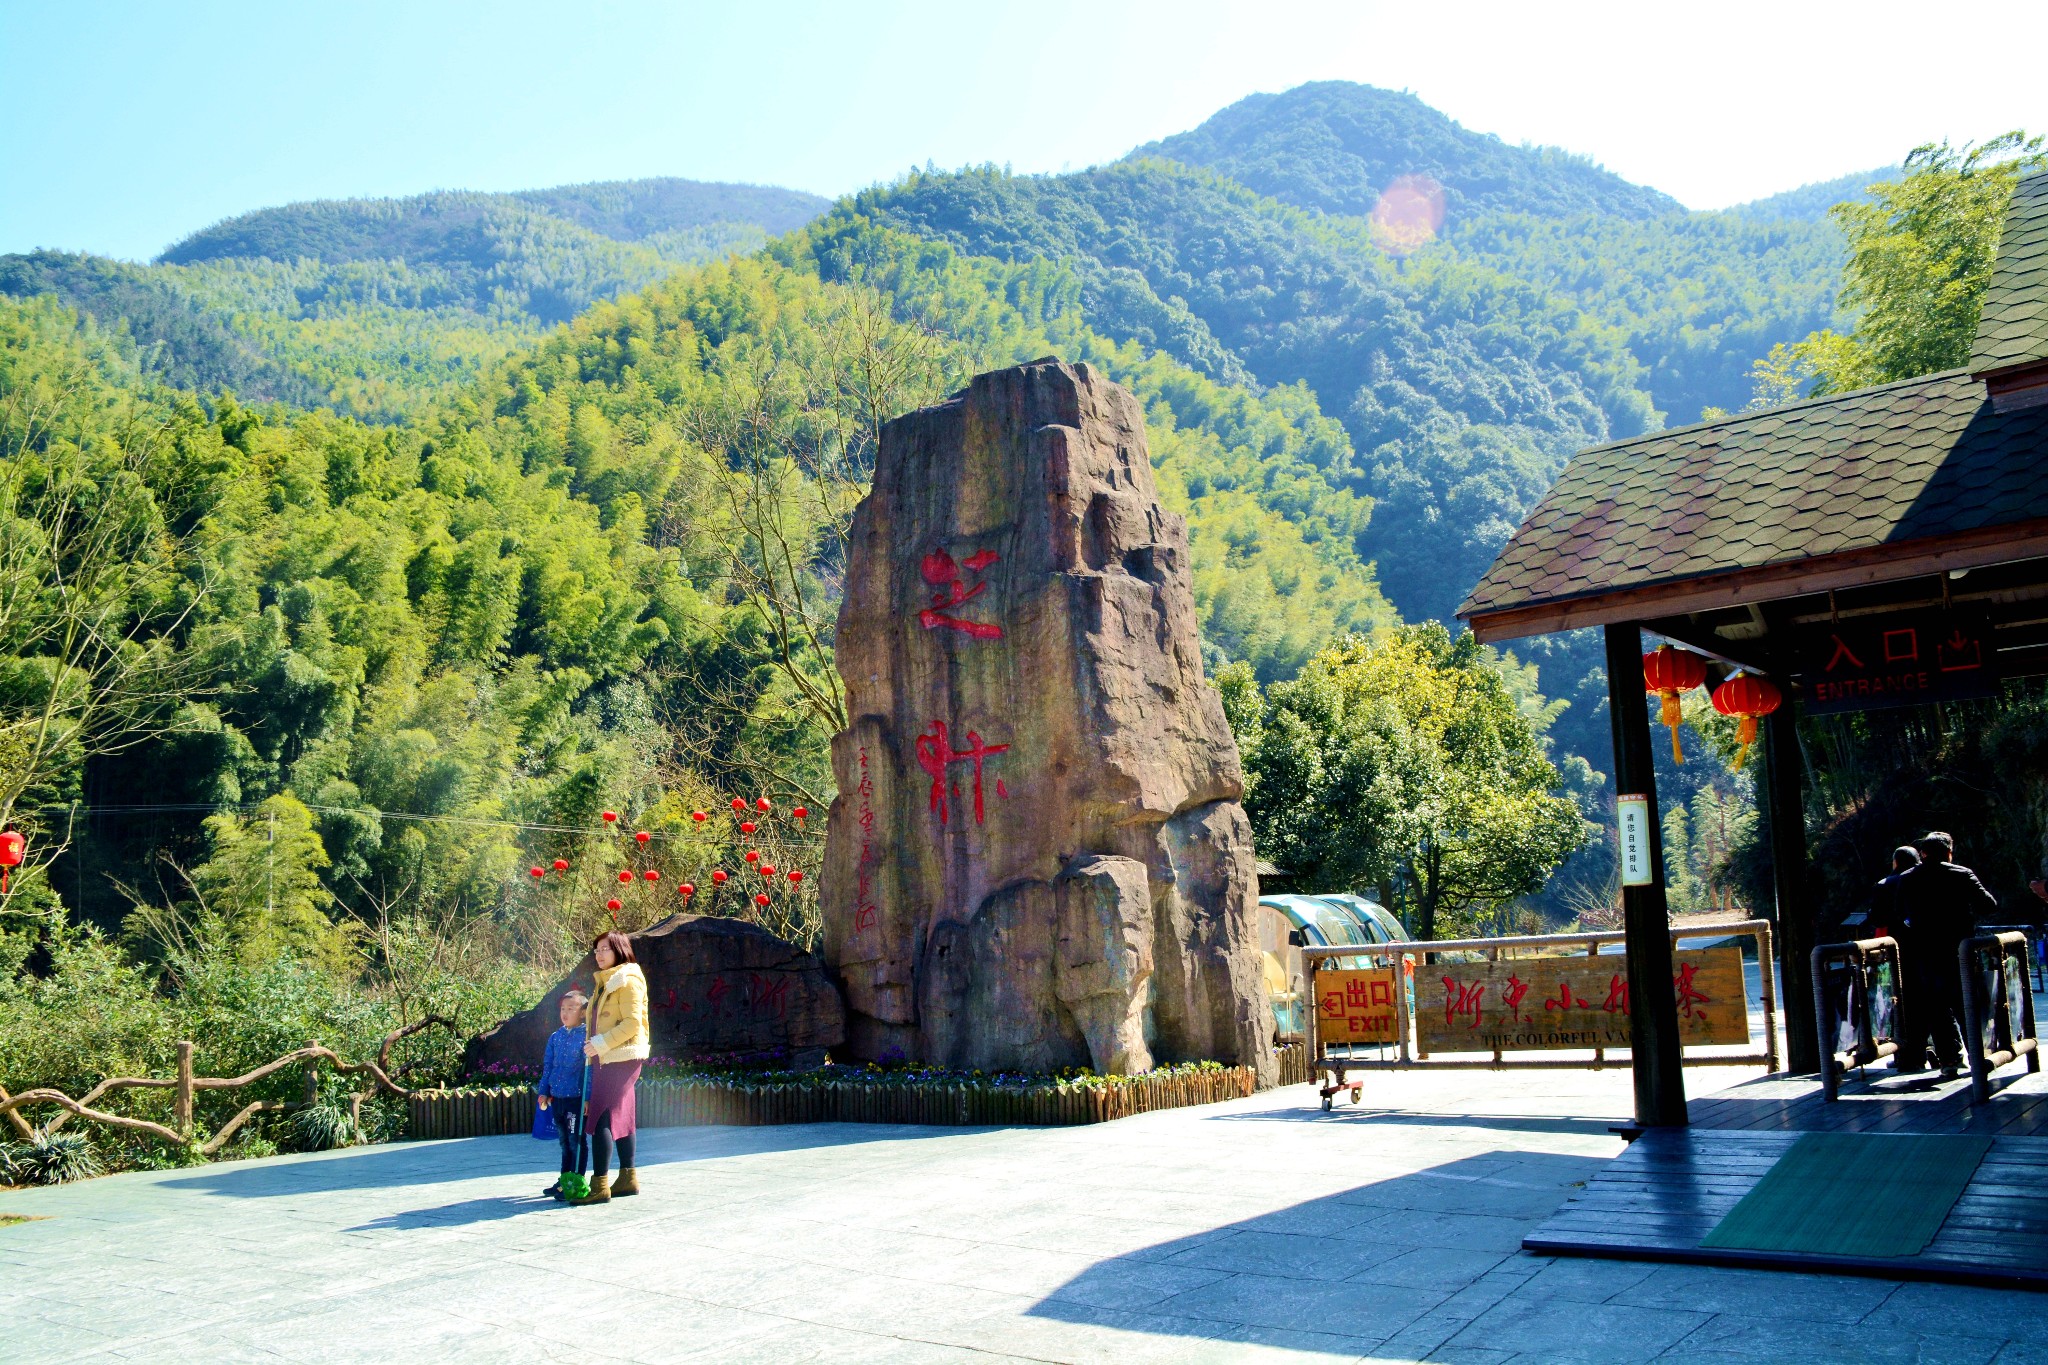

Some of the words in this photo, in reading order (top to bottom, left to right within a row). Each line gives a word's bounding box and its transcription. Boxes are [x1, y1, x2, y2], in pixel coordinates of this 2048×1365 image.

[1823, 627, 1919, 673] 入口
[1814, 671, 1929, 702] ENTRANCE
[1626, 813, 1638, 873] 请您自觉排队
[1346, 978, 1392, 1008] 出口
[1349, 1015, 1391, 1032] EXIT
[1481, 1034, 1512, 1047] THE
[1516, 1031, 1601, 1046] COLORFUL
